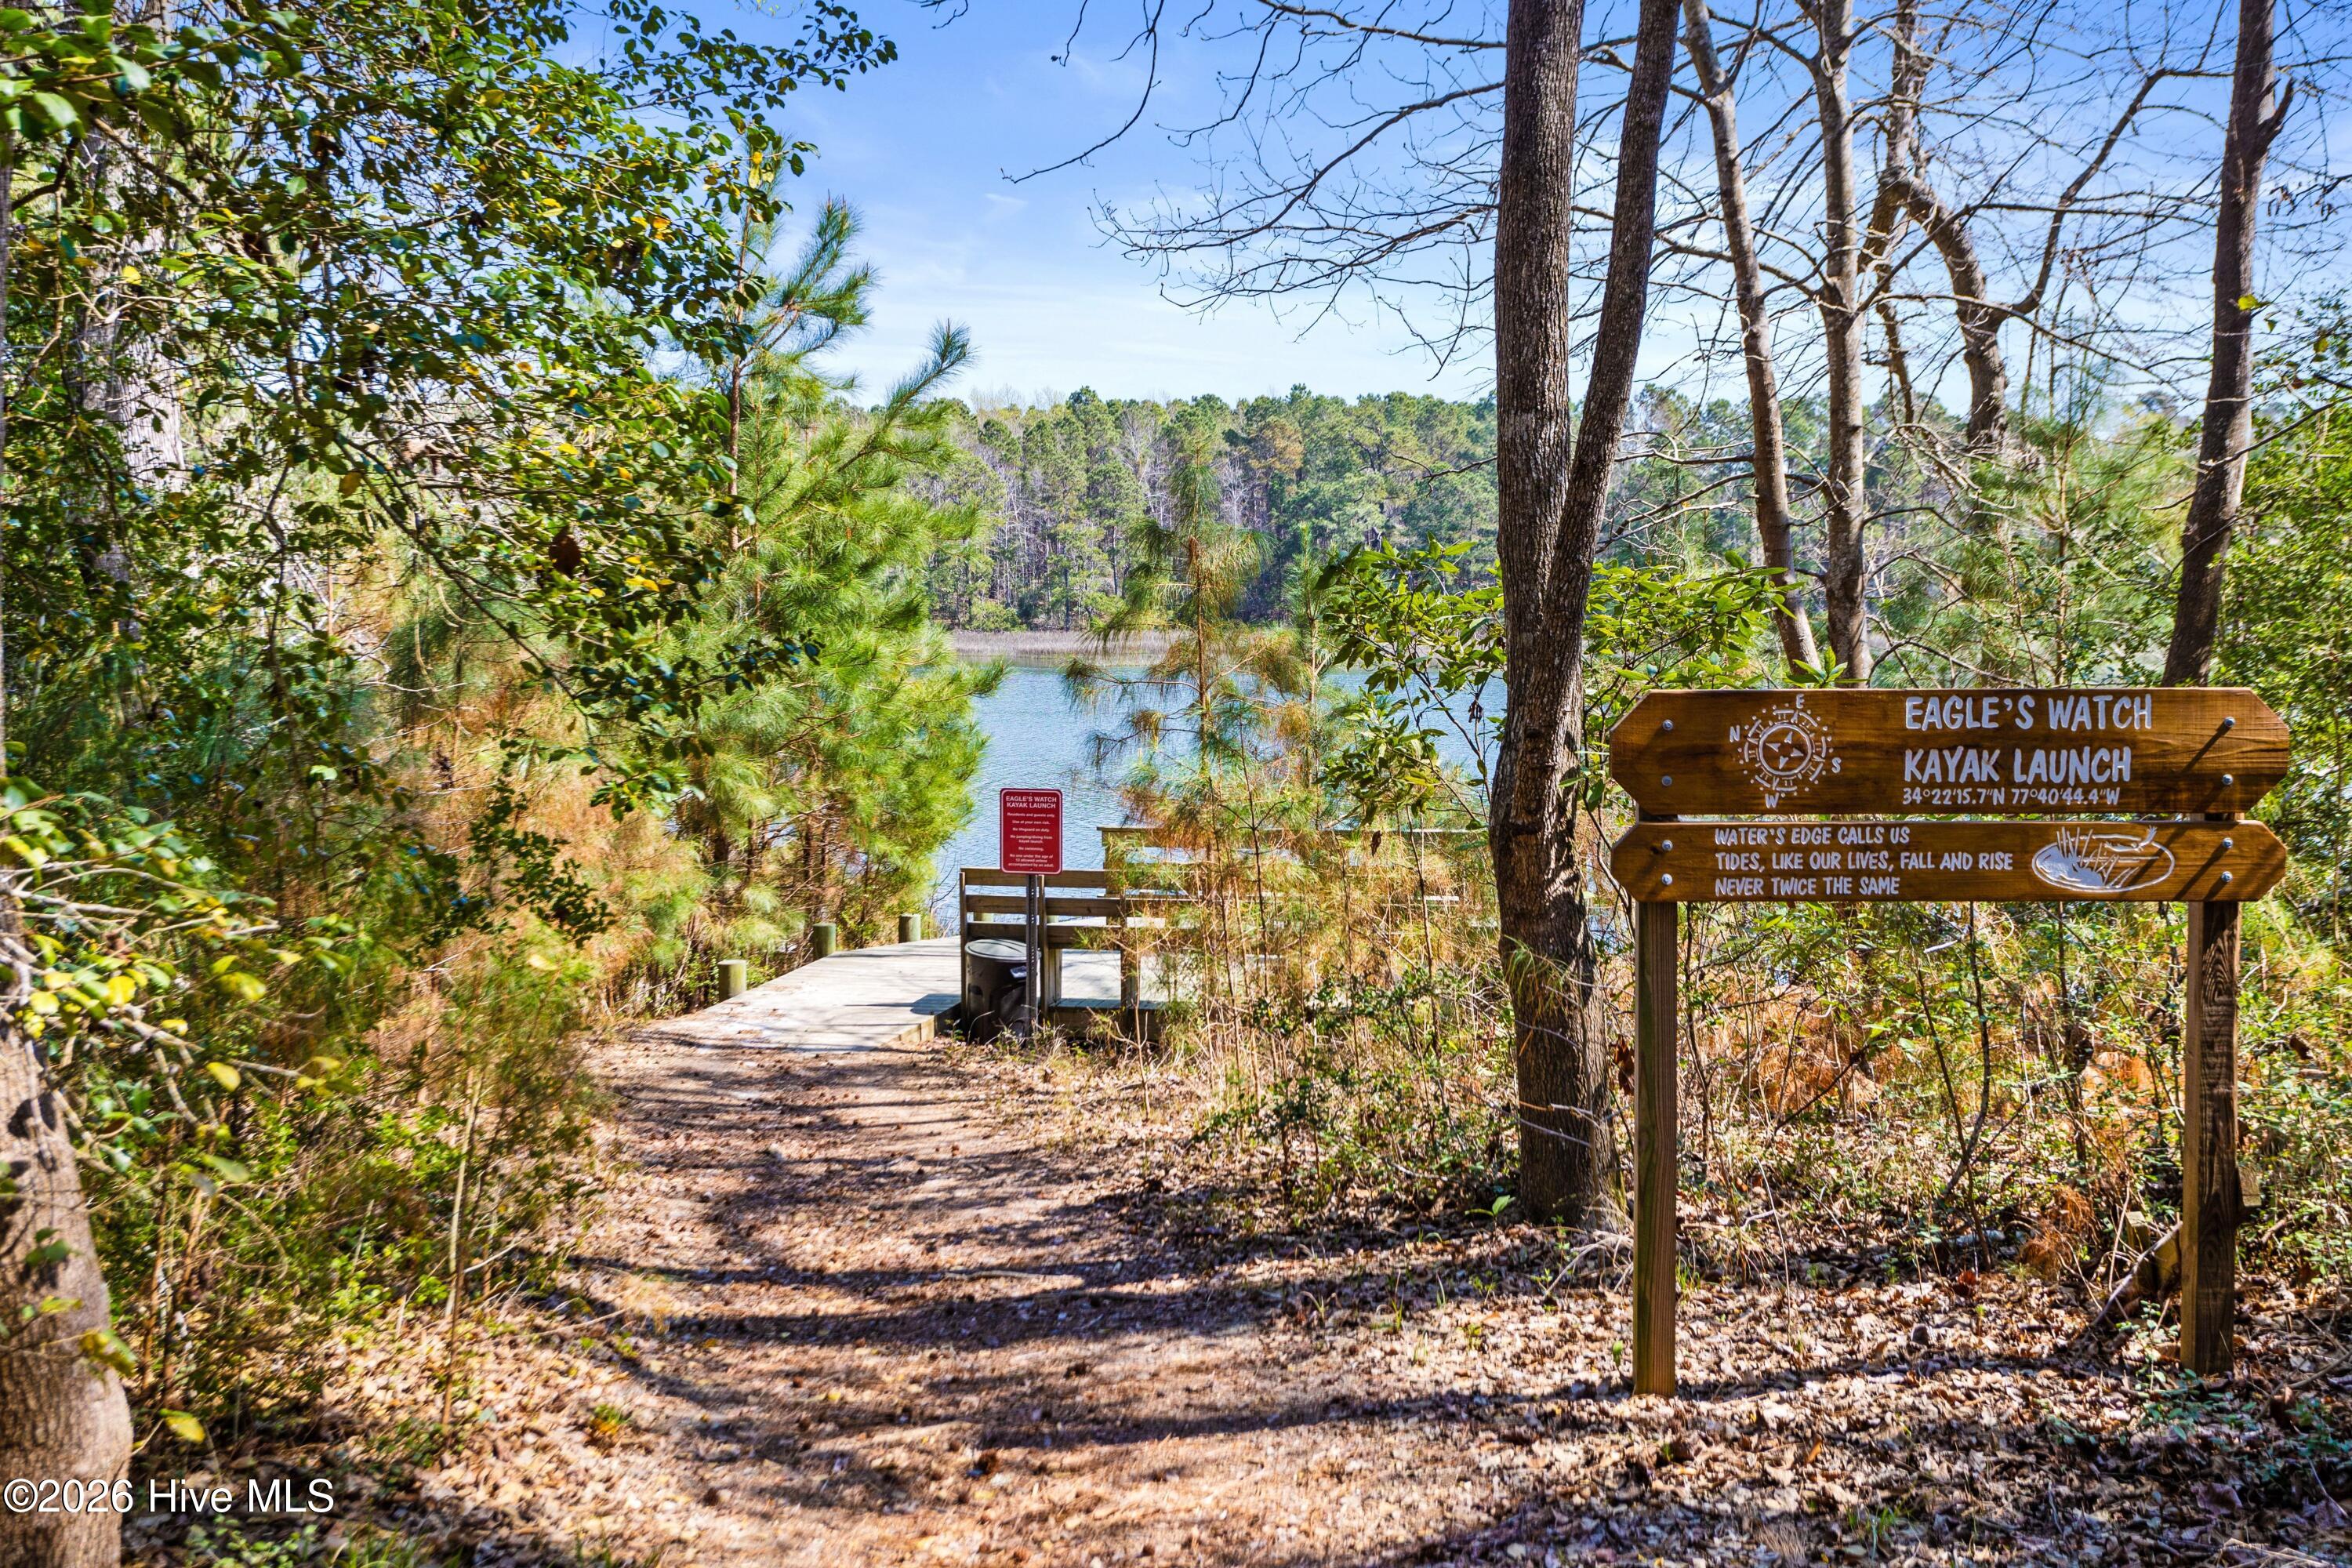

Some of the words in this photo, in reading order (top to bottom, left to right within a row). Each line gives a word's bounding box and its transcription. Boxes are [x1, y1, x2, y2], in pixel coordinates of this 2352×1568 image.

[1796, 694, 1805, 709] E
[1905, 694, 2035, 731] EAGLE'S
[2048, 694, 2152, 731] WATCH
[1729, 726, 1740, 742] N
[1832, 757, 1841, 773] S
[1904, 746, 2000, 784] KAYAK
[2014, 746, 2132, 786] LAUNCH
[1765, 793, 1780, 808] W
[1714, 827, 1786, 846] WATER'S
[1791, 827, 1831, 845] EDGE
[1837, 827, 1884, 845] CALLS
[1890, 827, 1910, 844] US
[1715, 853, 1765, 873] TIDES,
[1772, 853, 1803, 870] LIKE
[1810, 852, 1841, 871] OUR
[1847, 851, 1894, 872] LIVES,
[1900, 852, 1934, 870] FALL
[1940, 852, 1973, 871] AND
[1978, 851, 2013, 870] RISE
[1714, 877, 1764, 897] NEVER
[1771, 877, 1817, 896] TWICE
[1823, 876, 1852, 895] THE
[1859, 876, 1900, 895] SAME
